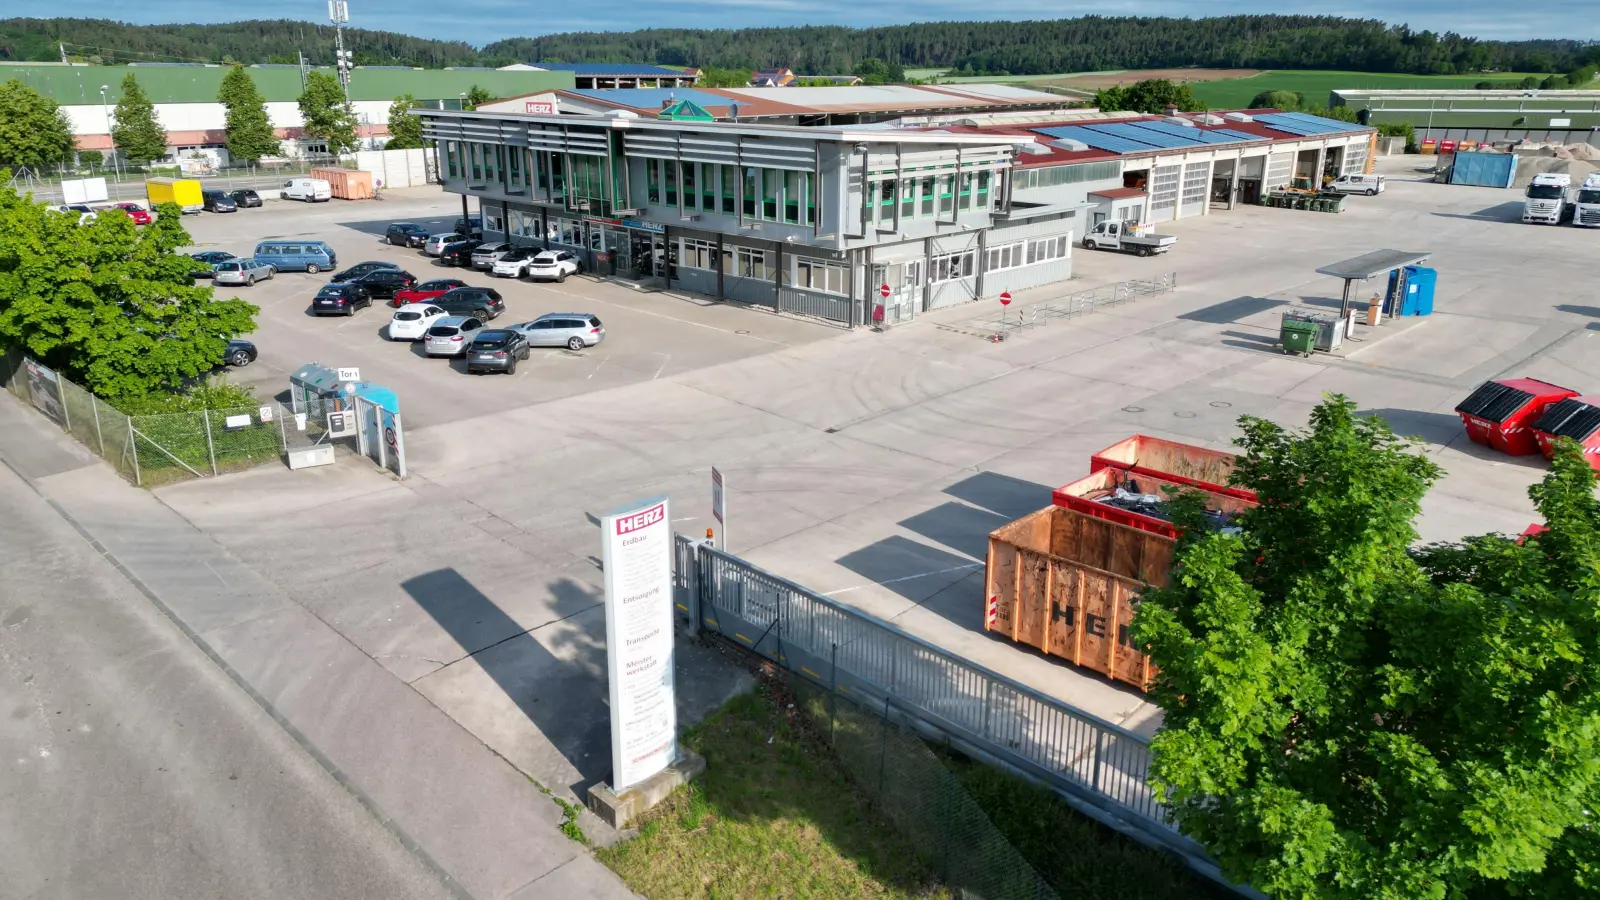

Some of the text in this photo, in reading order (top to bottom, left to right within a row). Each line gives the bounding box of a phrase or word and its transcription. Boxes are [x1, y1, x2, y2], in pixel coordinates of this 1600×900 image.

[527, 104, 551, 113] HERZ
[619, 507, 662, 533] HERZ
[622, 535, 647, 547] Erdbau
[623, 586, 660, 604] Entsorgung
